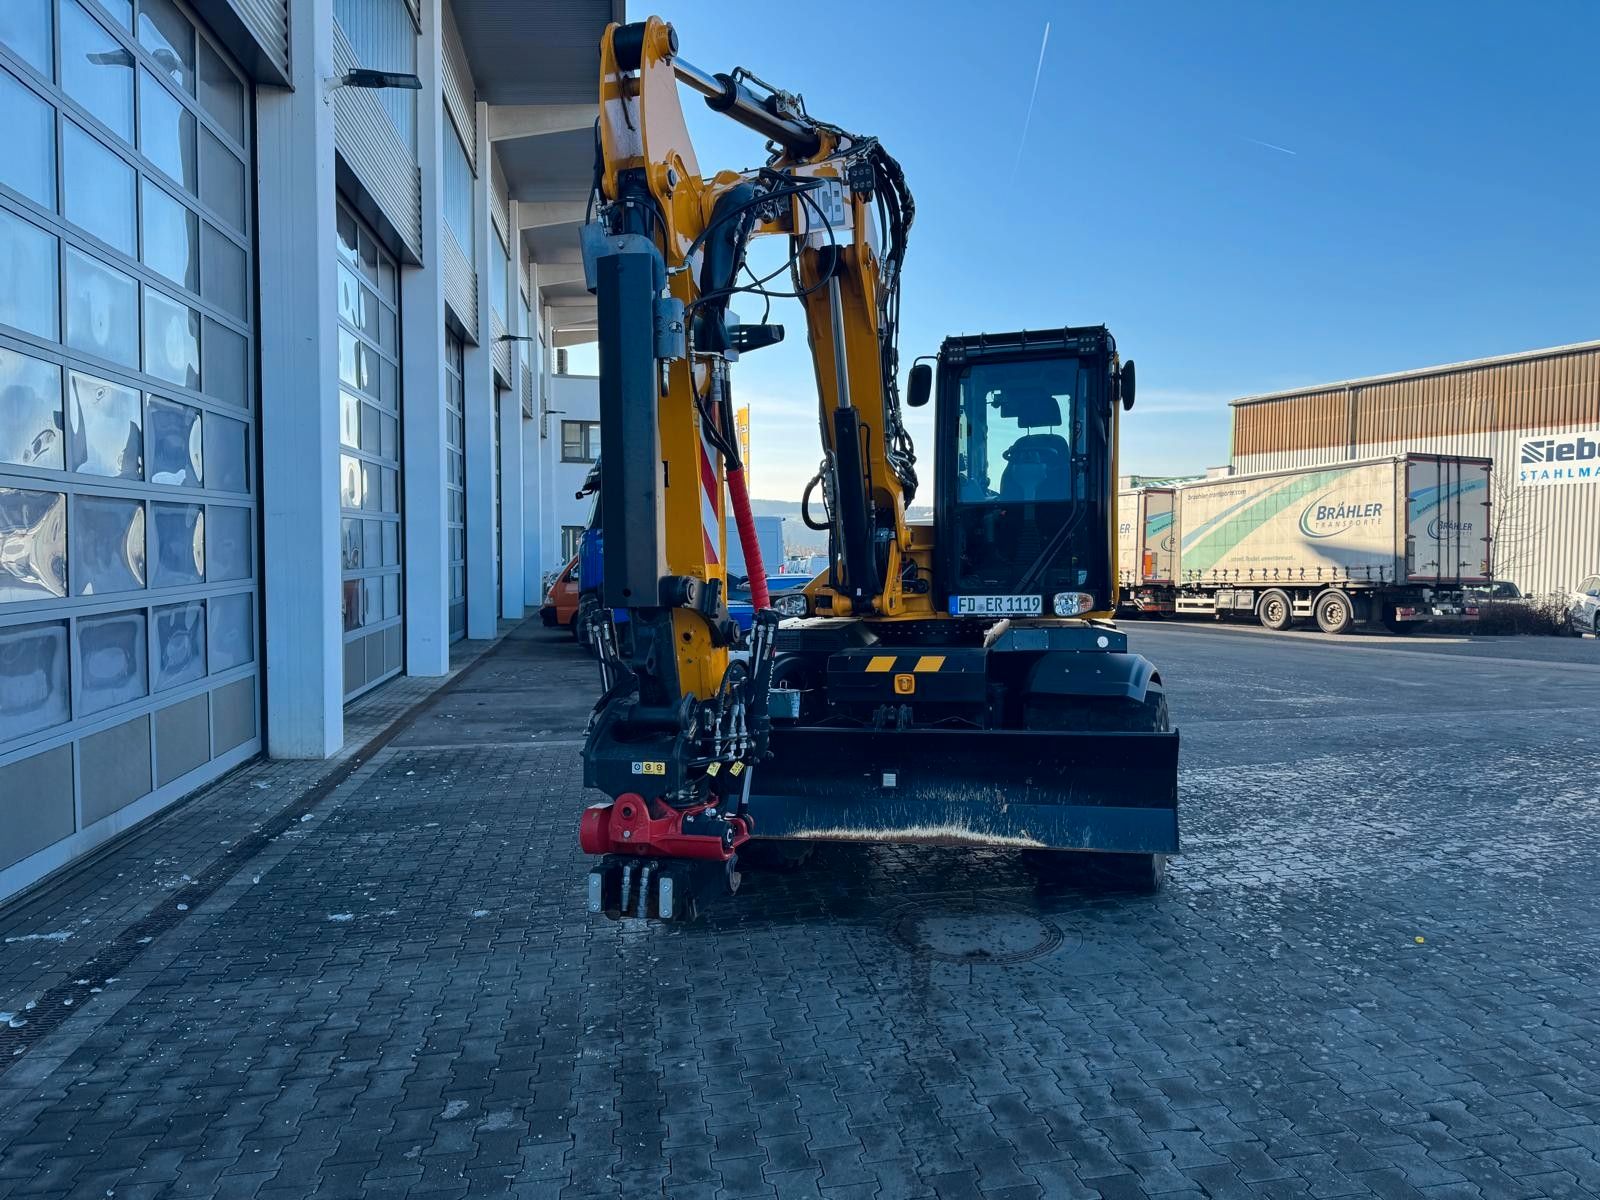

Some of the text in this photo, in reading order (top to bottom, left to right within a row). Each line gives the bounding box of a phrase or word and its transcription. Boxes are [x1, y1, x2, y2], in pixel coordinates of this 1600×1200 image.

[1521, 437, 1600, 464] Sieb
[1316, 501, 1383, 520] BRÄHLER
[1315, 518, 1383, 528] TRANSPORTE
[958, 597, 1041, 612] FD ER 1119
